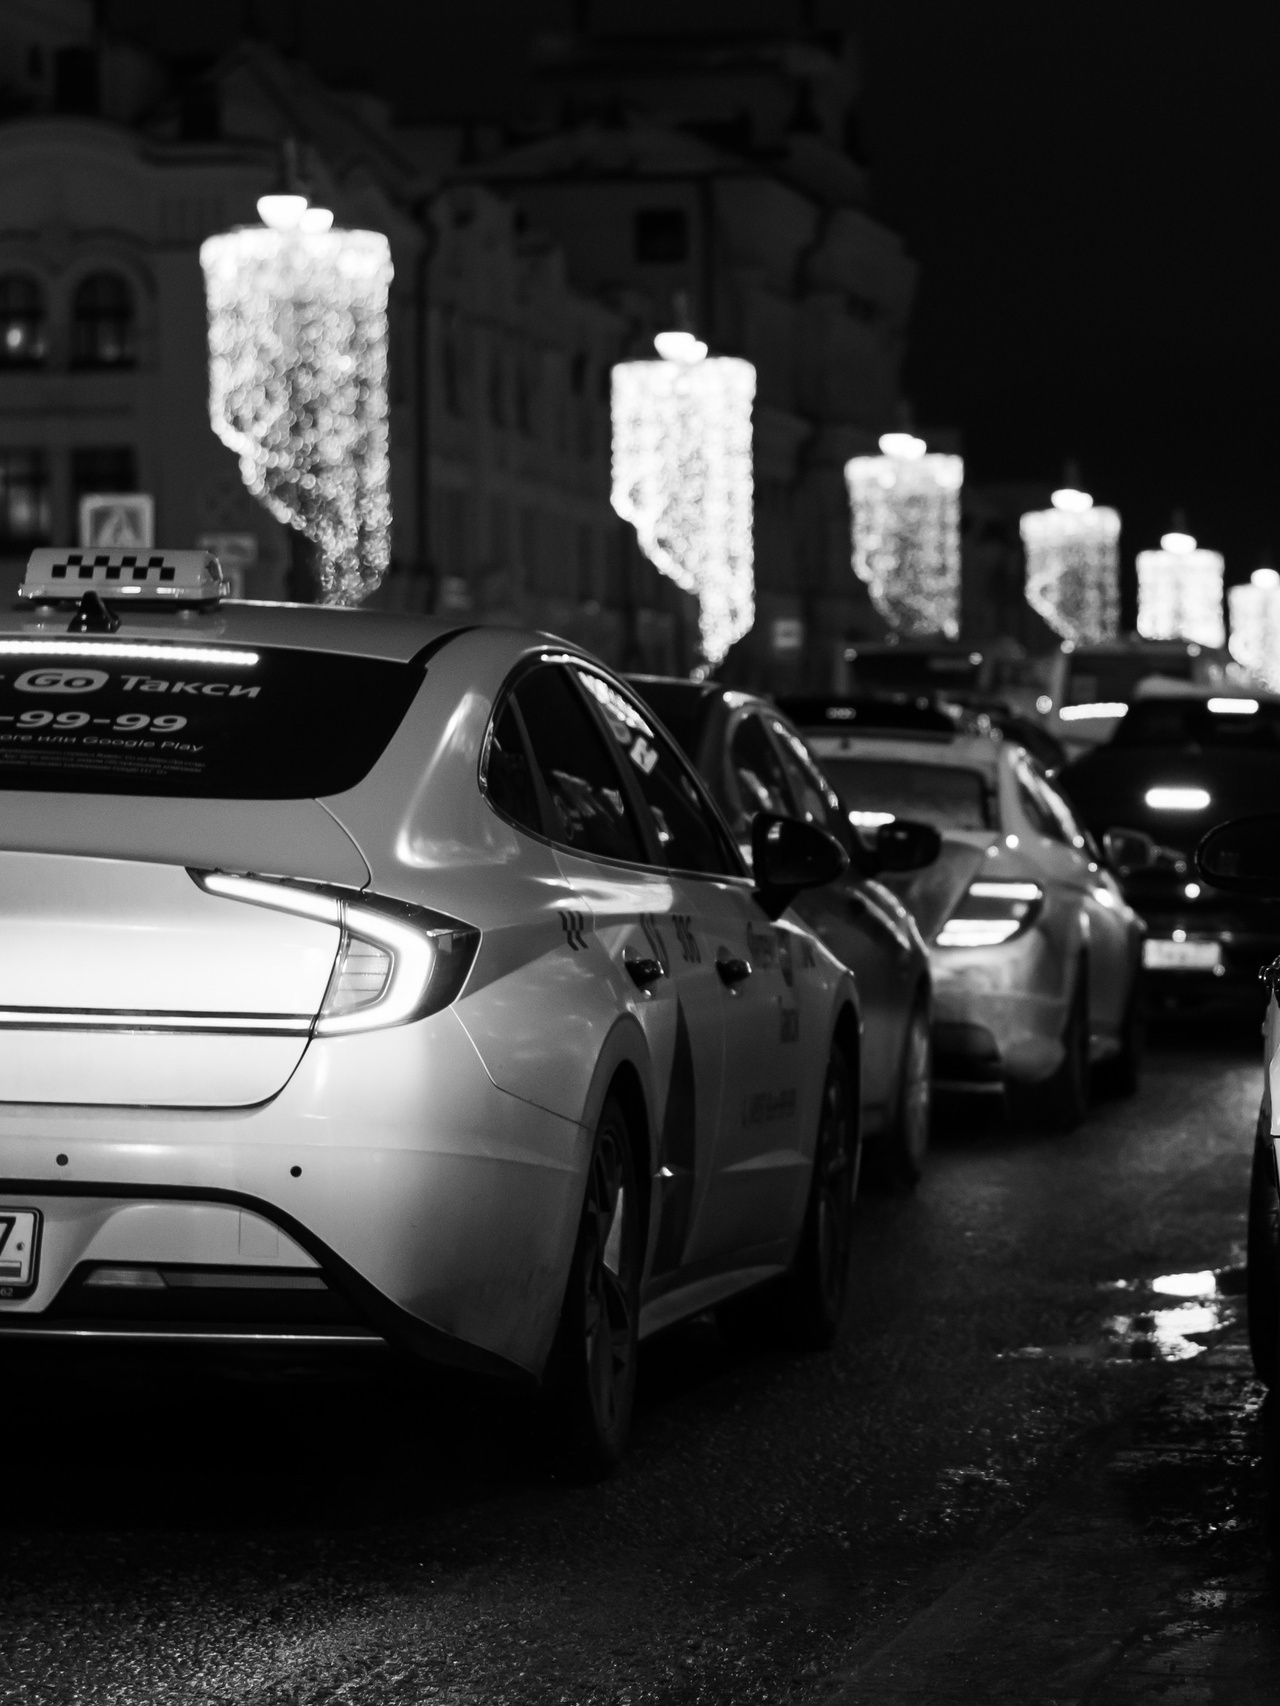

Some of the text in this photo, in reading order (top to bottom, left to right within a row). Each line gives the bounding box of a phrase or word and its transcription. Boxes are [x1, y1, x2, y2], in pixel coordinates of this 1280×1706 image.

[120, 674, 263, 699] Такси
[37, 735, 77, 745] или
[82, 736, 156, 749] Google
[160, 741, 205, 753] Play
